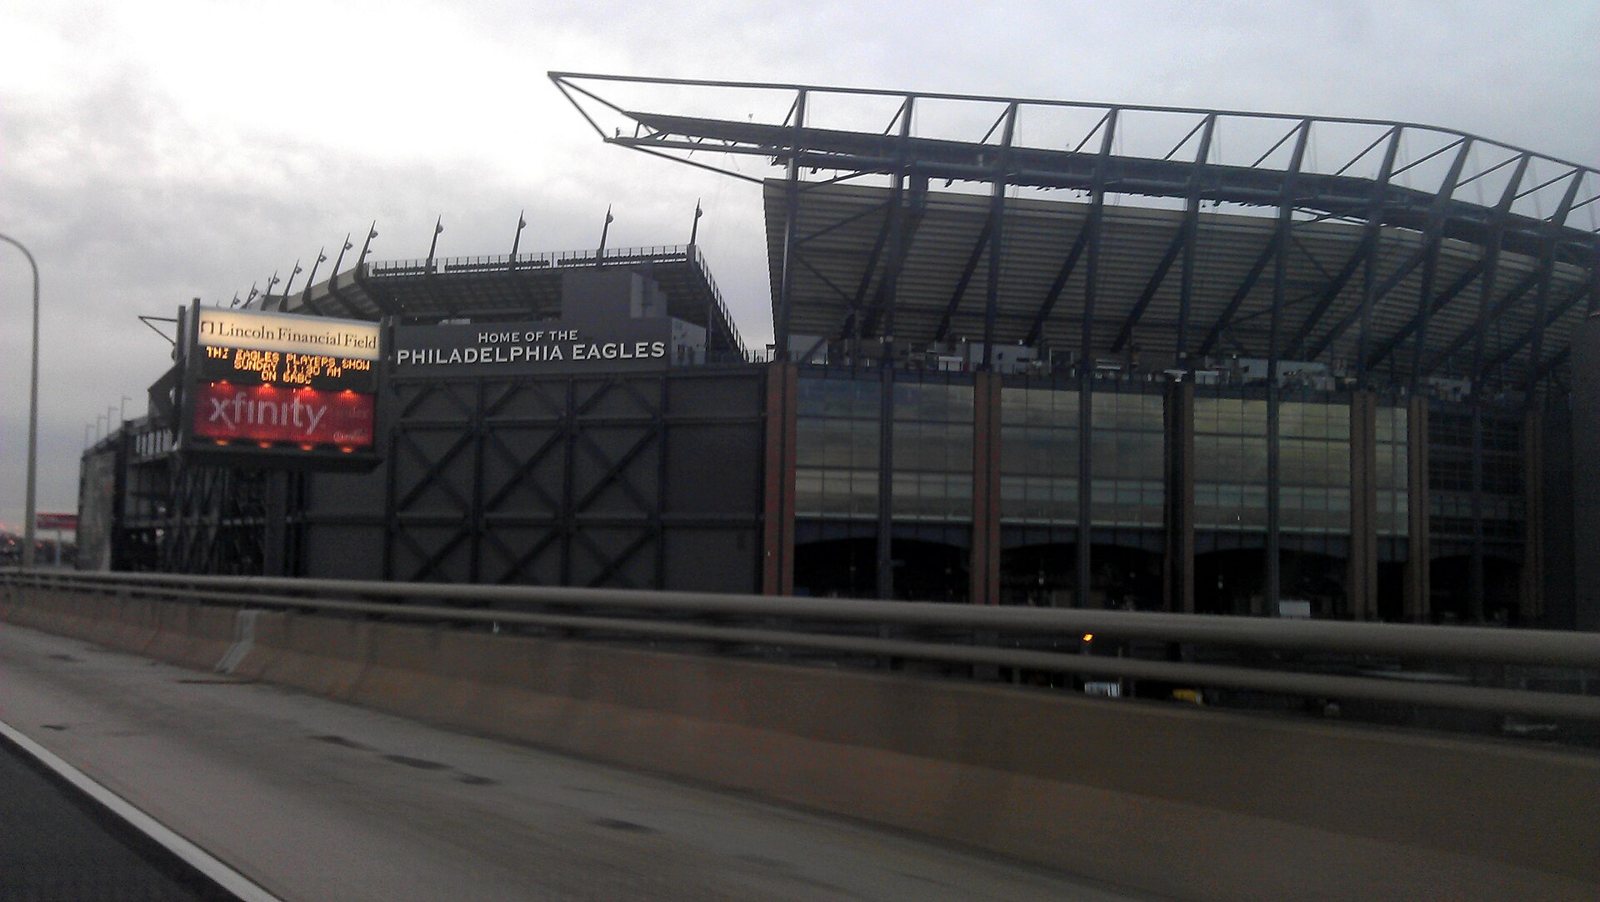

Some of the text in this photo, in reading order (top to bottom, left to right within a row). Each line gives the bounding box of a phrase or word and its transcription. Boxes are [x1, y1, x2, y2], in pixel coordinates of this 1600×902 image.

[219, 322, 377, 349] Lincoln Financial Field
[478, 329, 579, 344] HOME OF THE
[235, 349, 280, 364] EAGLES
[285, 352, 336, 368] PLAYERS
[341, 358, 371, 371] SHOW
[397, 341, 666, 366] PHILADELPHIA EAGLES
[234, 357, 278, 372] SUNDAY
[326, 366, 341, 378] AM
[261, 370, 277, 382] ON
[209, 392, 327, 435] xfinity
